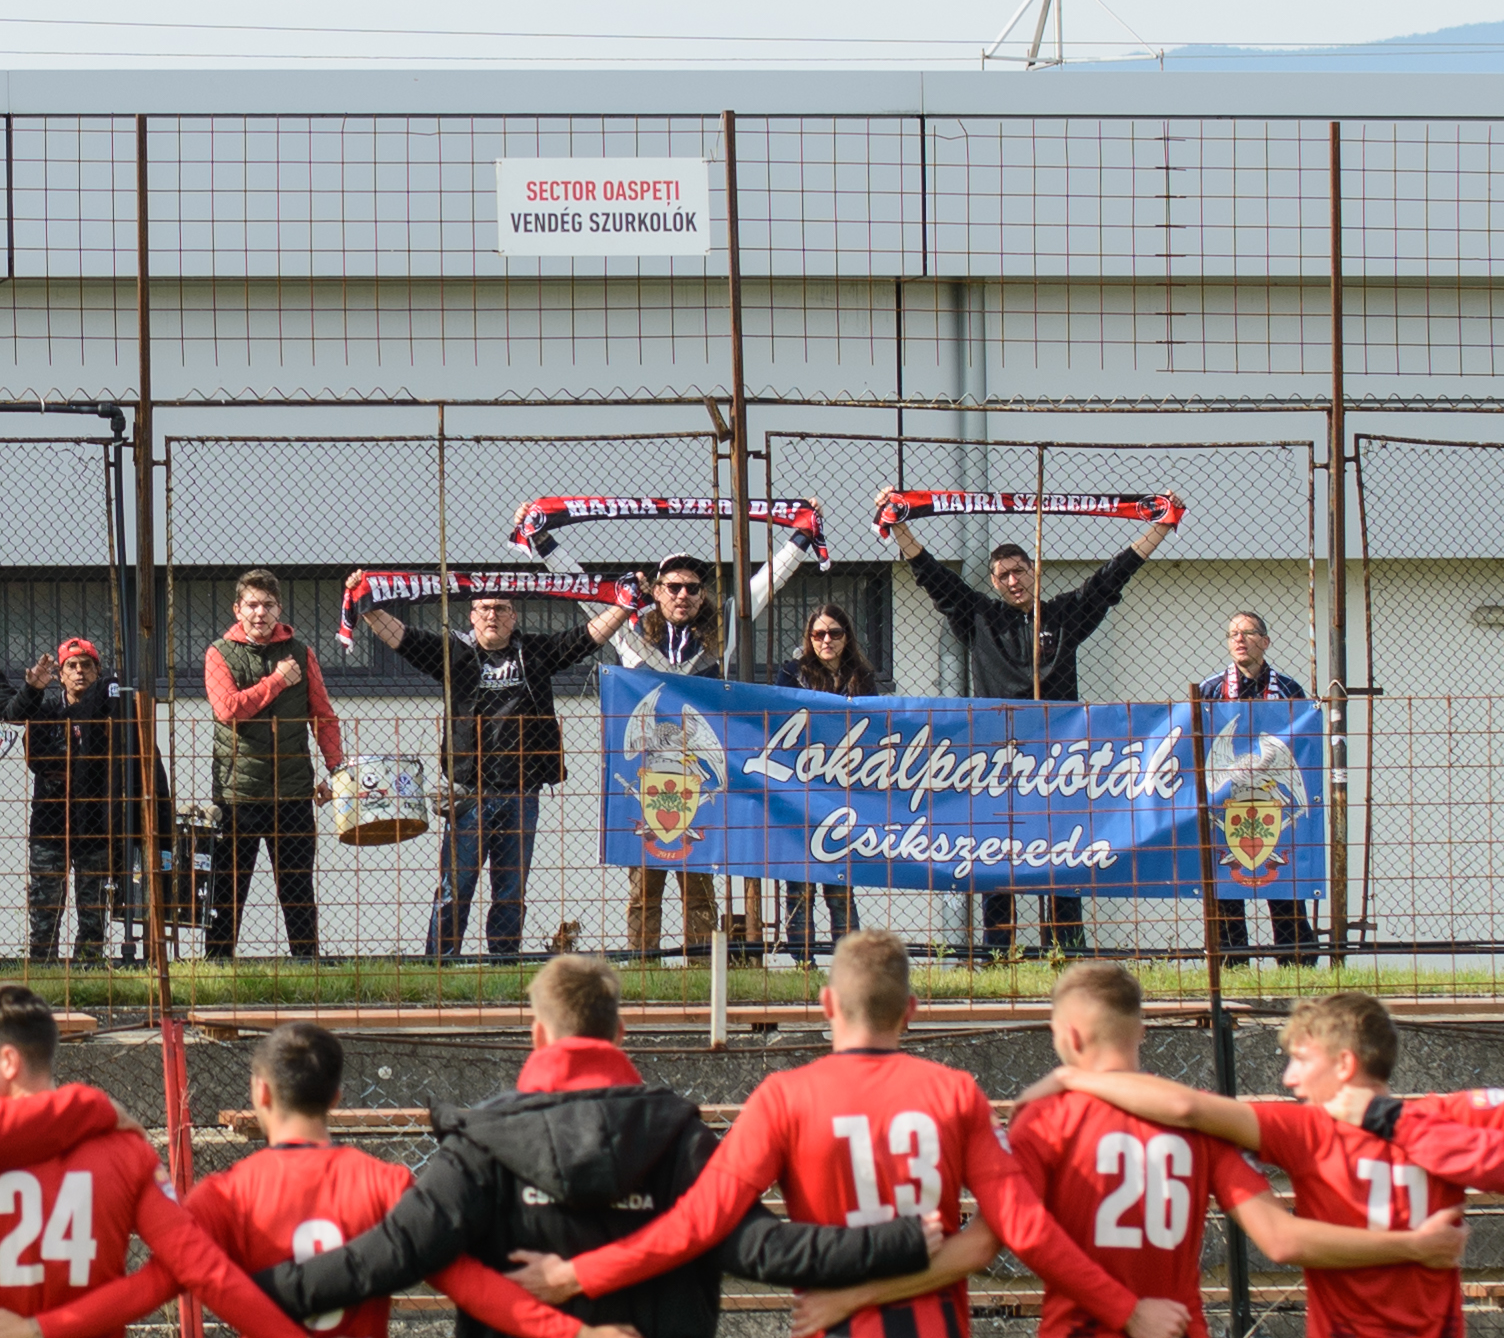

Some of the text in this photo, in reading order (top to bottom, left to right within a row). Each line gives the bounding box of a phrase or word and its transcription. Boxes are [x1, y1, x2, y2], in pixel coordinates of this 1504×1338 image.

[526, 180, 680, 207] SECTOR OASPEȚI
[510, 206, 697, 233] VENDÉG SZURKOLÓK
[667, 497, 801, 520] SZERDA!
[469, 572, 603, 595] SZEREDA!
[742, 708, 1183, 812] Lokálpatrióták
[810, 806, 1118, 879] Csíkszereda
[833, 1112, 941, 1228] 13
[1095, 1132, 1192, 1250] 26
